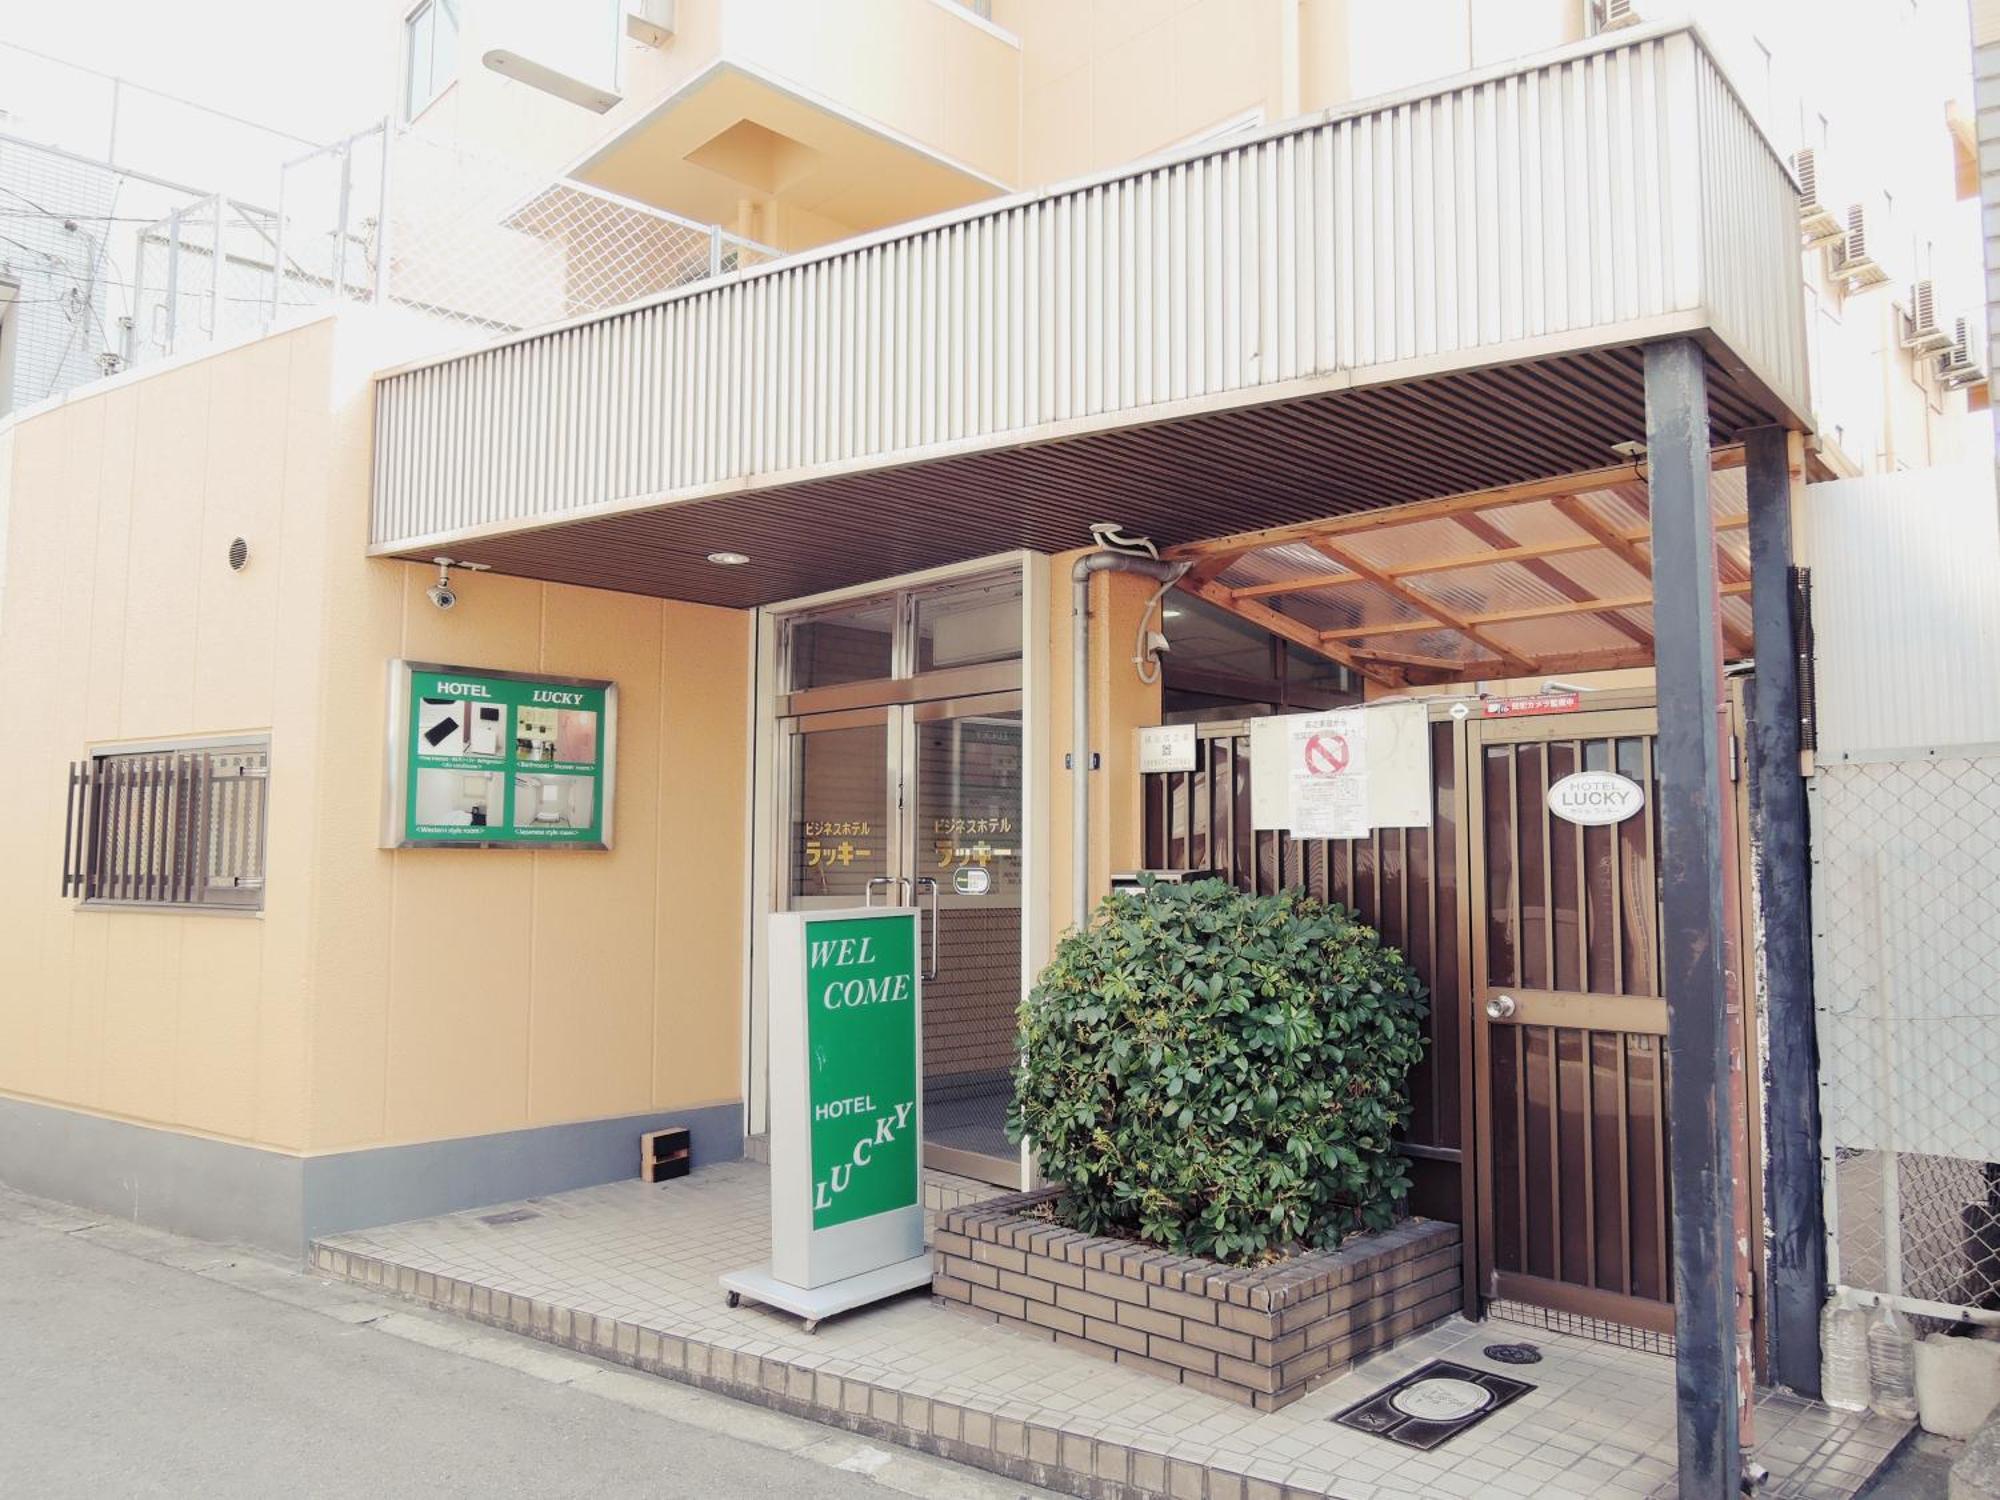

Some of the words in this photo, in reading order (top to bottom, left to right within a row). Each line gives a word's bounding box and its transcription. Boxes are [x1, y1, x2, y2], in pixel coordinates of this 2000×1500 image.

[437, 682, 491, 697] HOTEL
[533, 690, 582, 704] LUCKY
[1562, 792, 1630, 806] LUCKY
[1570, 783, 1620, 791] HOTEL
[806, 821, 870, 836] ビジネスホテル
[935, 817, 1012, 833] ビジネスホテル
[806, 840, 871, 866] ラッキー
[934, 840, 1012, 868] ラッキー
[811, 937, 876, 969] WEL
[823, 974, 910, 1009] COME
[815, 1095, 877, 1121] HOTEL
[813, 1101, 914, 1210] LUCKY
